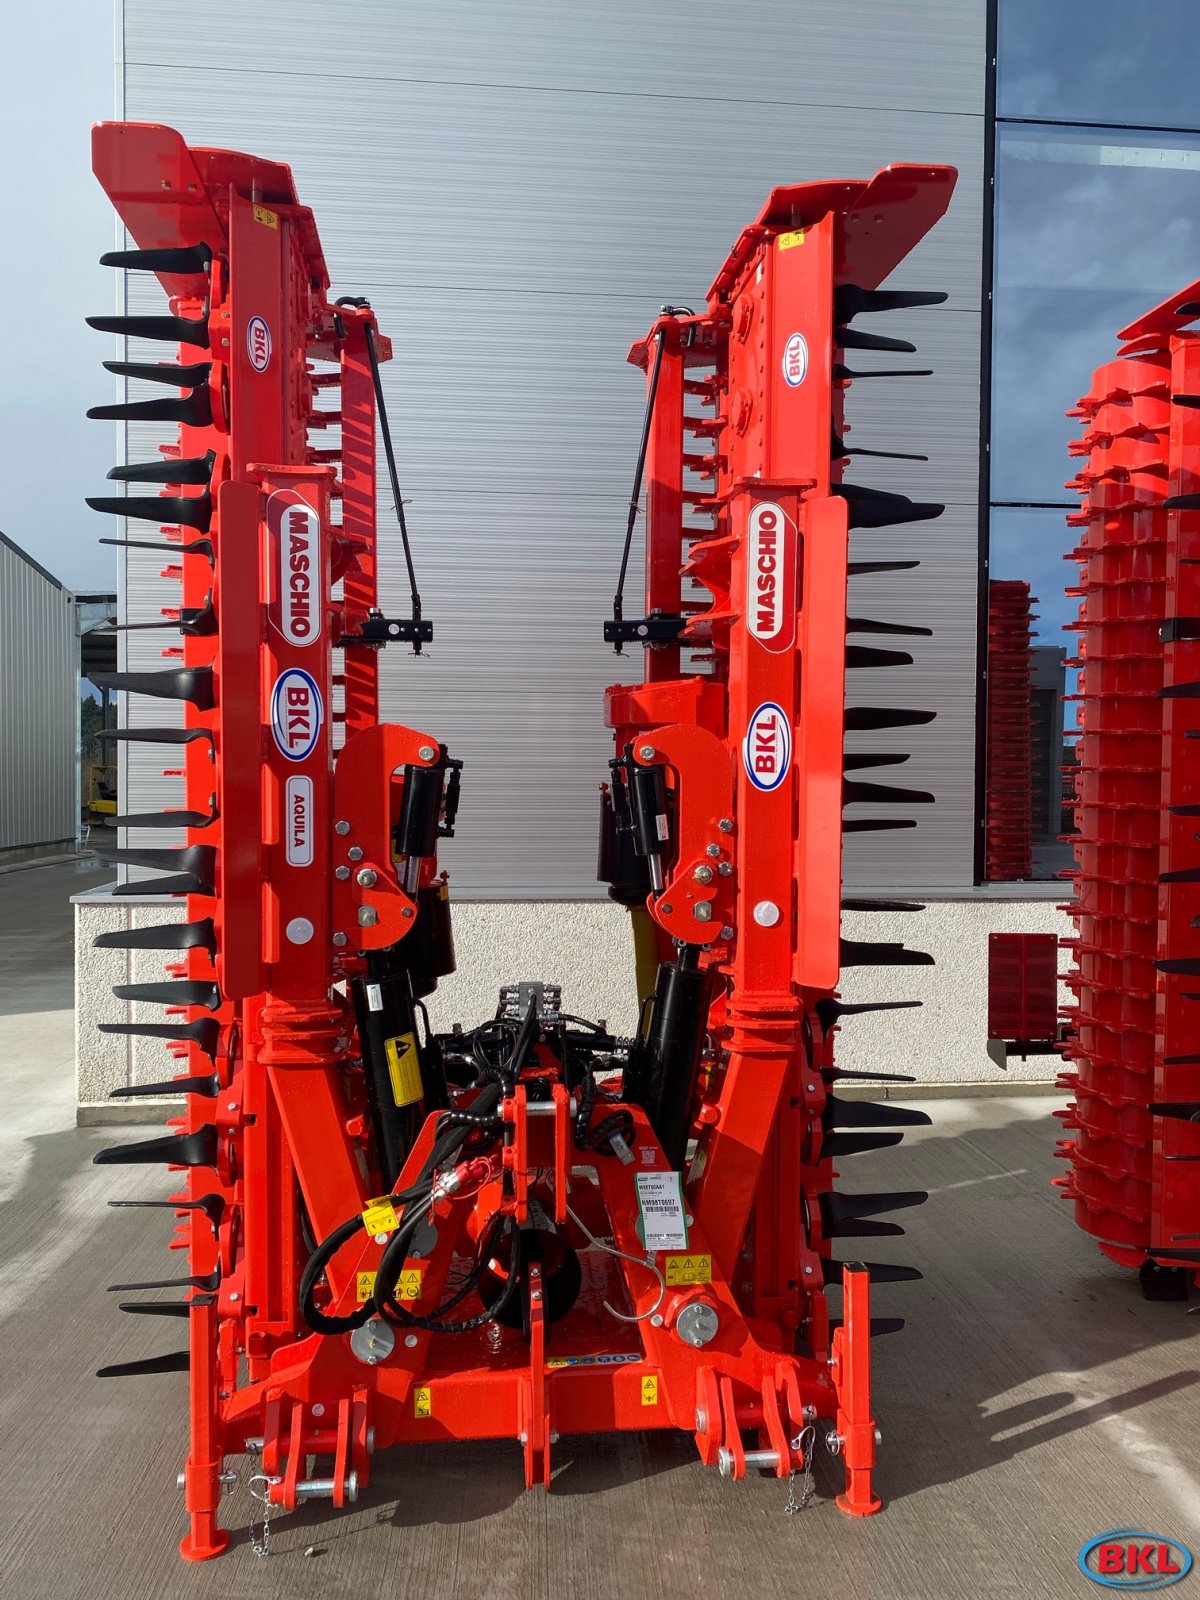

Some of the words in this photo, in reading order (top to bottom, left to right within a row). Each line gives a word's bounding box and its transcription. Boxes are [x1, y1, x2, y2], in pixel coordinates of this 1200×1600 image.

[253, 327, 266, 364] BKL
[789, 341, 801, 377] BKL
[289, 511, 311, 638] MASCHIO
[756, 510, 778, 632] MASCHIO
[288, 687, 310, 748] BKL
[756, 715, 776, 774] BKL
[294, 794, 305, 848] AQUILA
